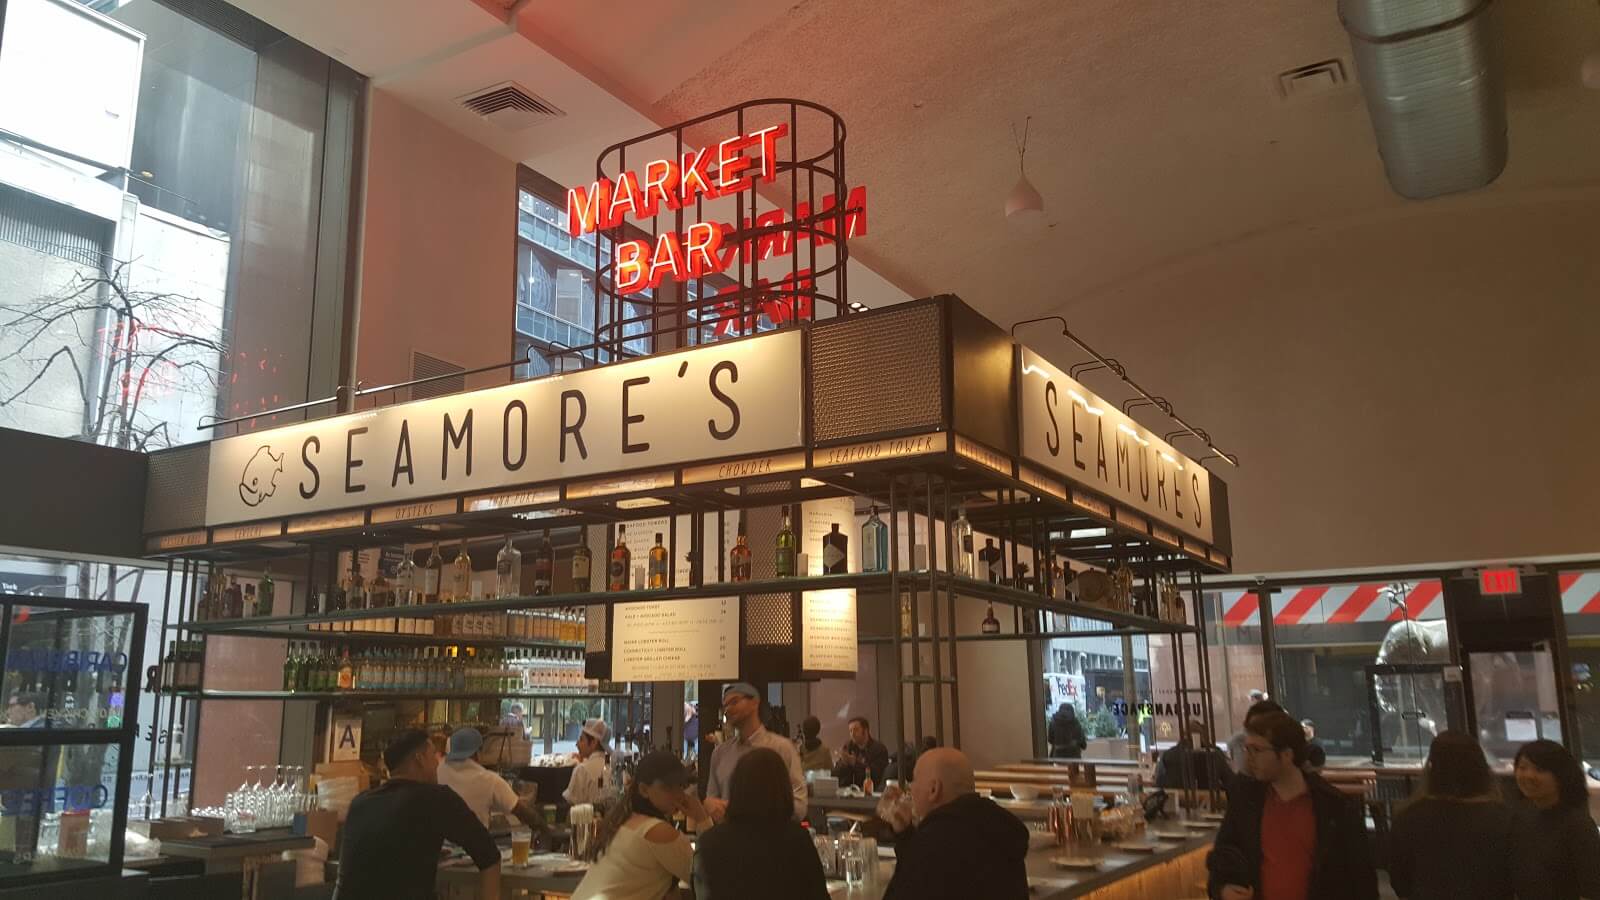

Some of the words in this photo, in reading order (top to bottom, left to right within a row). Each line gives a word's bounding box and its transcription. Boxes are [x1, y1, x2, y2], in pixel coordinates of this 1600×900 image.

[566, 122, 788, 240] MARKET
[615, 220, 725, 295] BAR
[298, 360, 741, 500] SEAMORE'S
[826, 444, 882, 465] SEAFOOD
[888, 435, 934, 455] TOWER
[1044, 380, 1203, 529] SEAMORES
[718, 457, 774, 479] CHOWDER
[395, 502, 434, 519] OYSTERS
[1483, 571, 1518, 593] EXIT
[1057, 677, 1078, 697] FedEx
[339, 724, 356, 750] A
